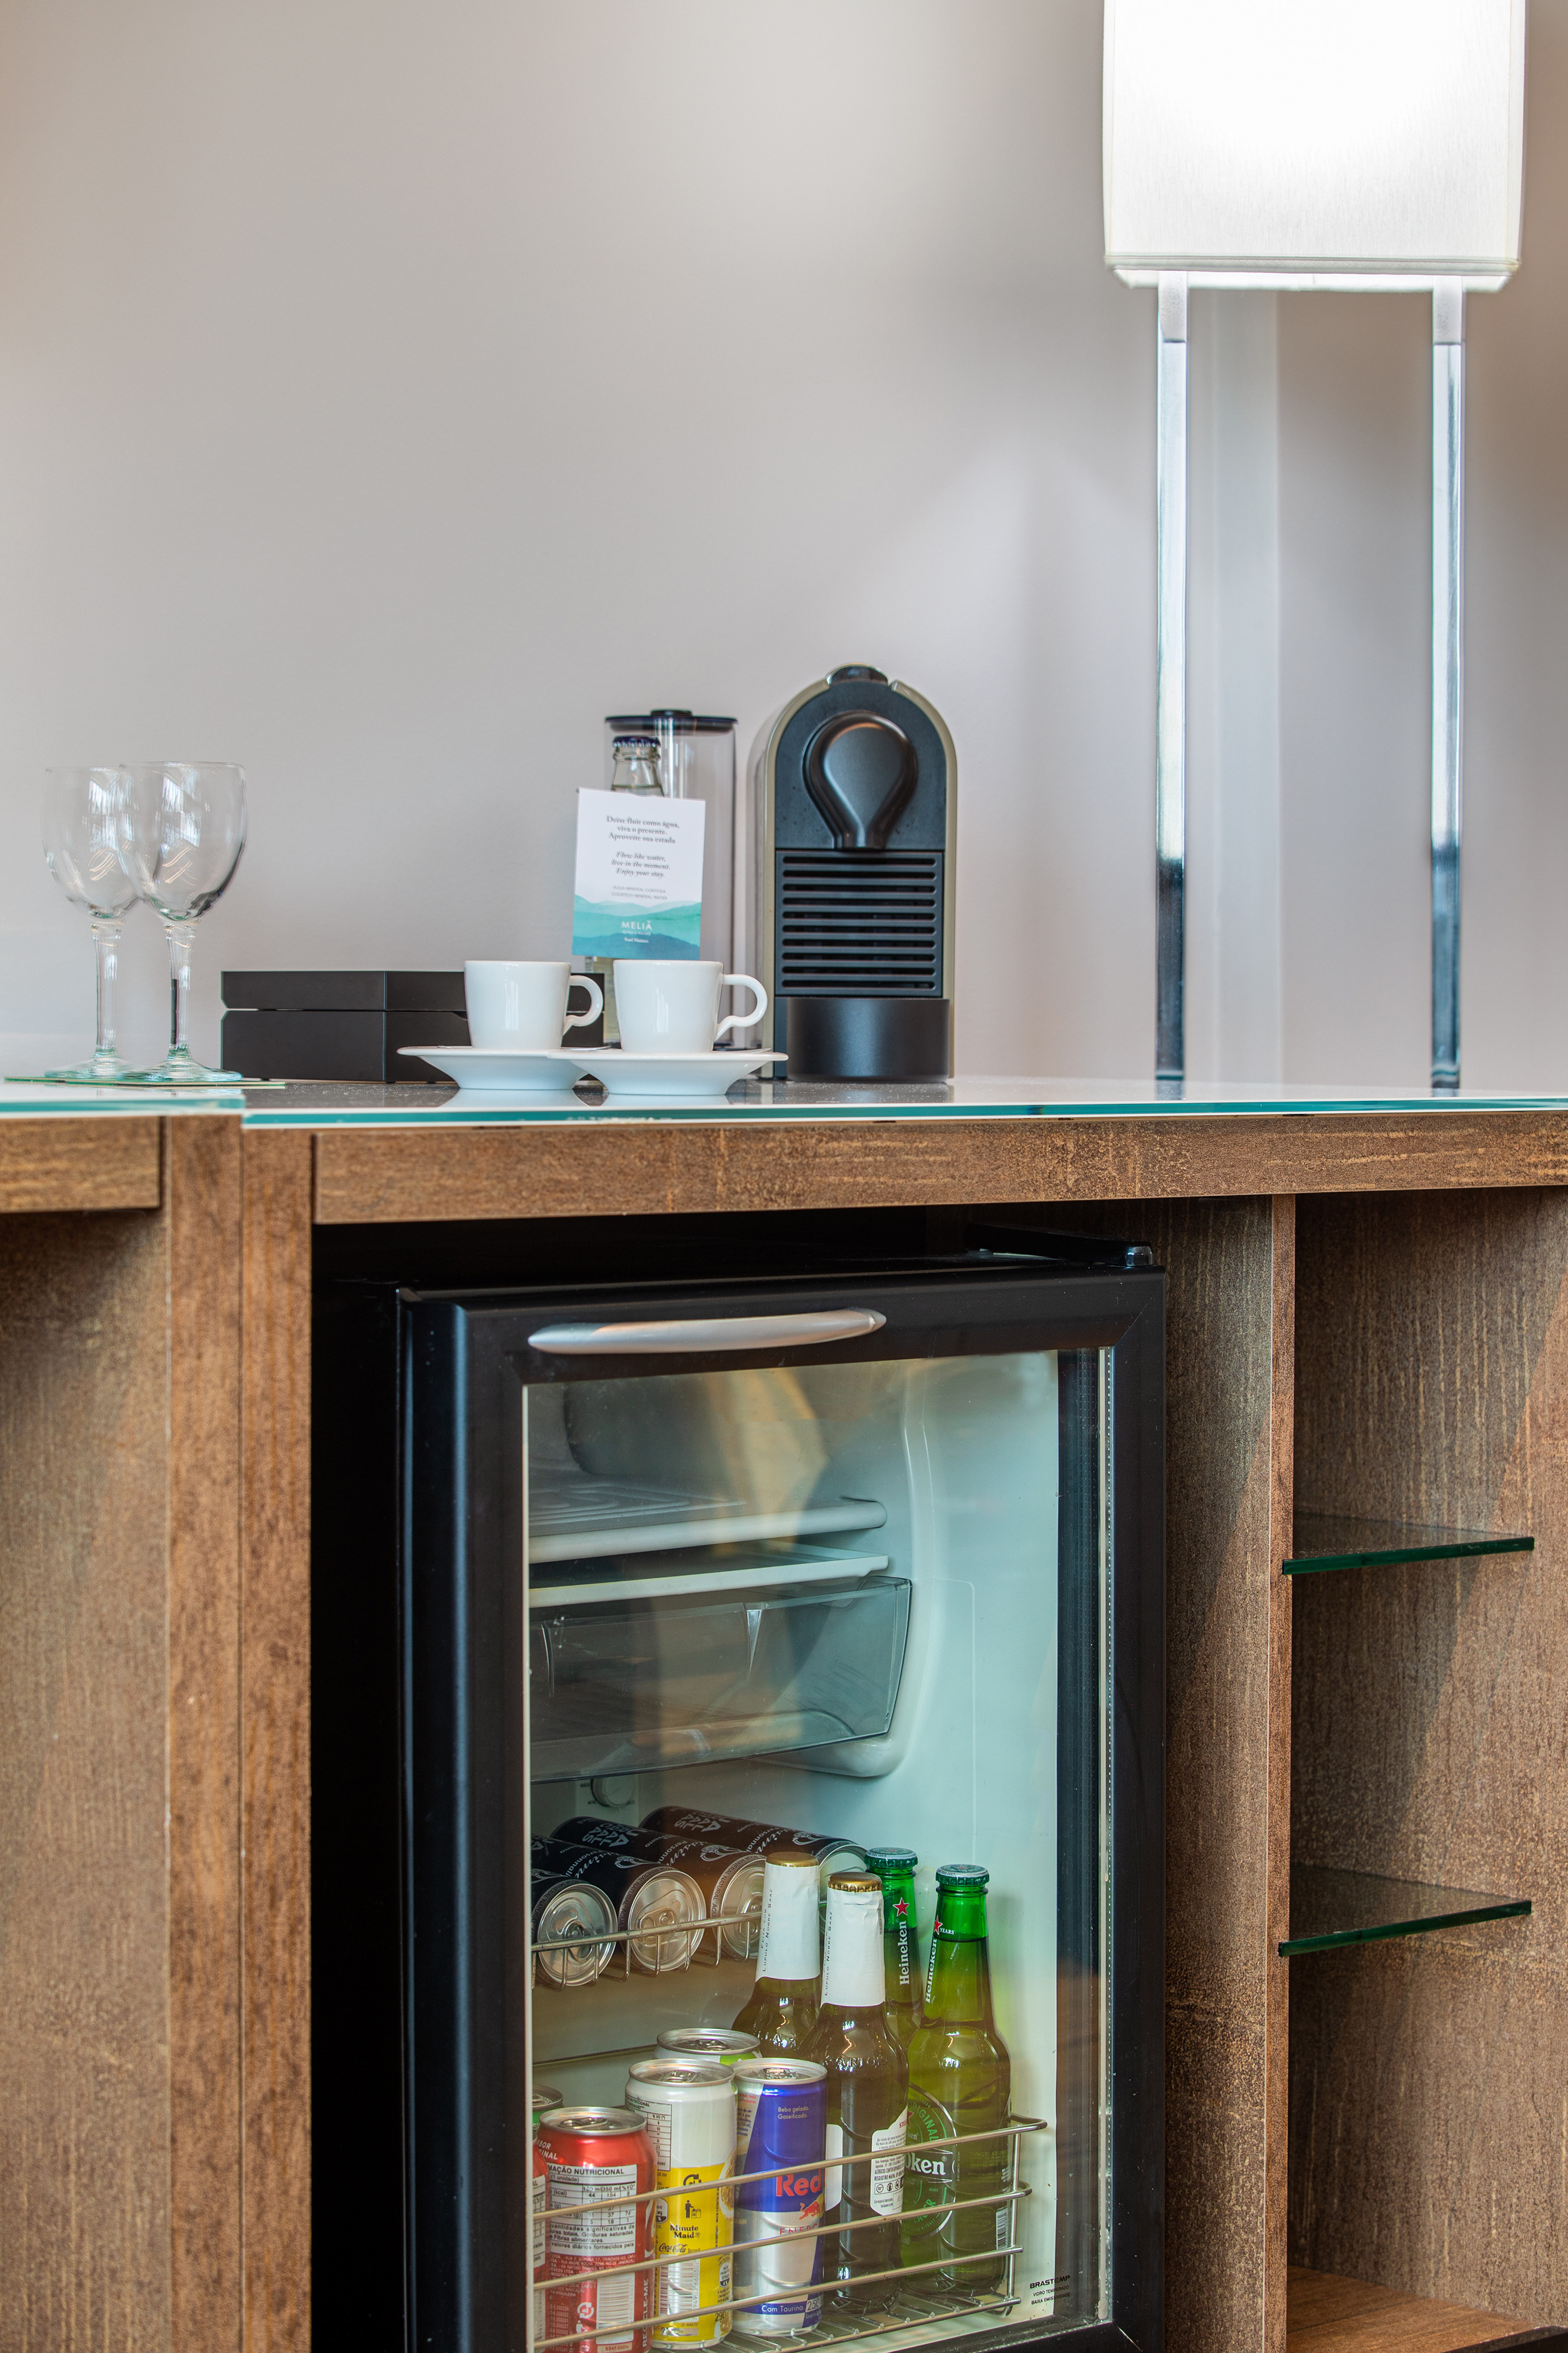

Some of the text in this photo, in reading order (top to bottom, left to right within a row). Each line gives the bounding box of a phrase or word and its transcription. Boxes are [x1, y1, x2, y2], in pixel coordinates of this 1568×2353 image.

[607, 815, 626, 824] Deixe
[609, 832, 641, 841] Aproveite
[617, 868, 635, 877] Enjoy
[623, 1879, 641, 1906] NATURAL
[713, 1875, 728, 1901] NATURAL
[898, 1920, 909, 1985] Heineken
[925, 1939, 937, 2003] Heineken
[536, 2139, 551, 2150] ABOR
[548, 2164, 572, 2174] MAÇÃO
[776, 2169, 825, 2196] Red
[1030, 2275, 1071, 2289] BRASTEMP
[1046, 2285, 1070, 2294] TEMPERADO
[1044, 2292, 1071, 2302] EMISSIVIDADE
[807, 2298, 820, 2311] 250
[715, 2311, 726, 2322] 290
